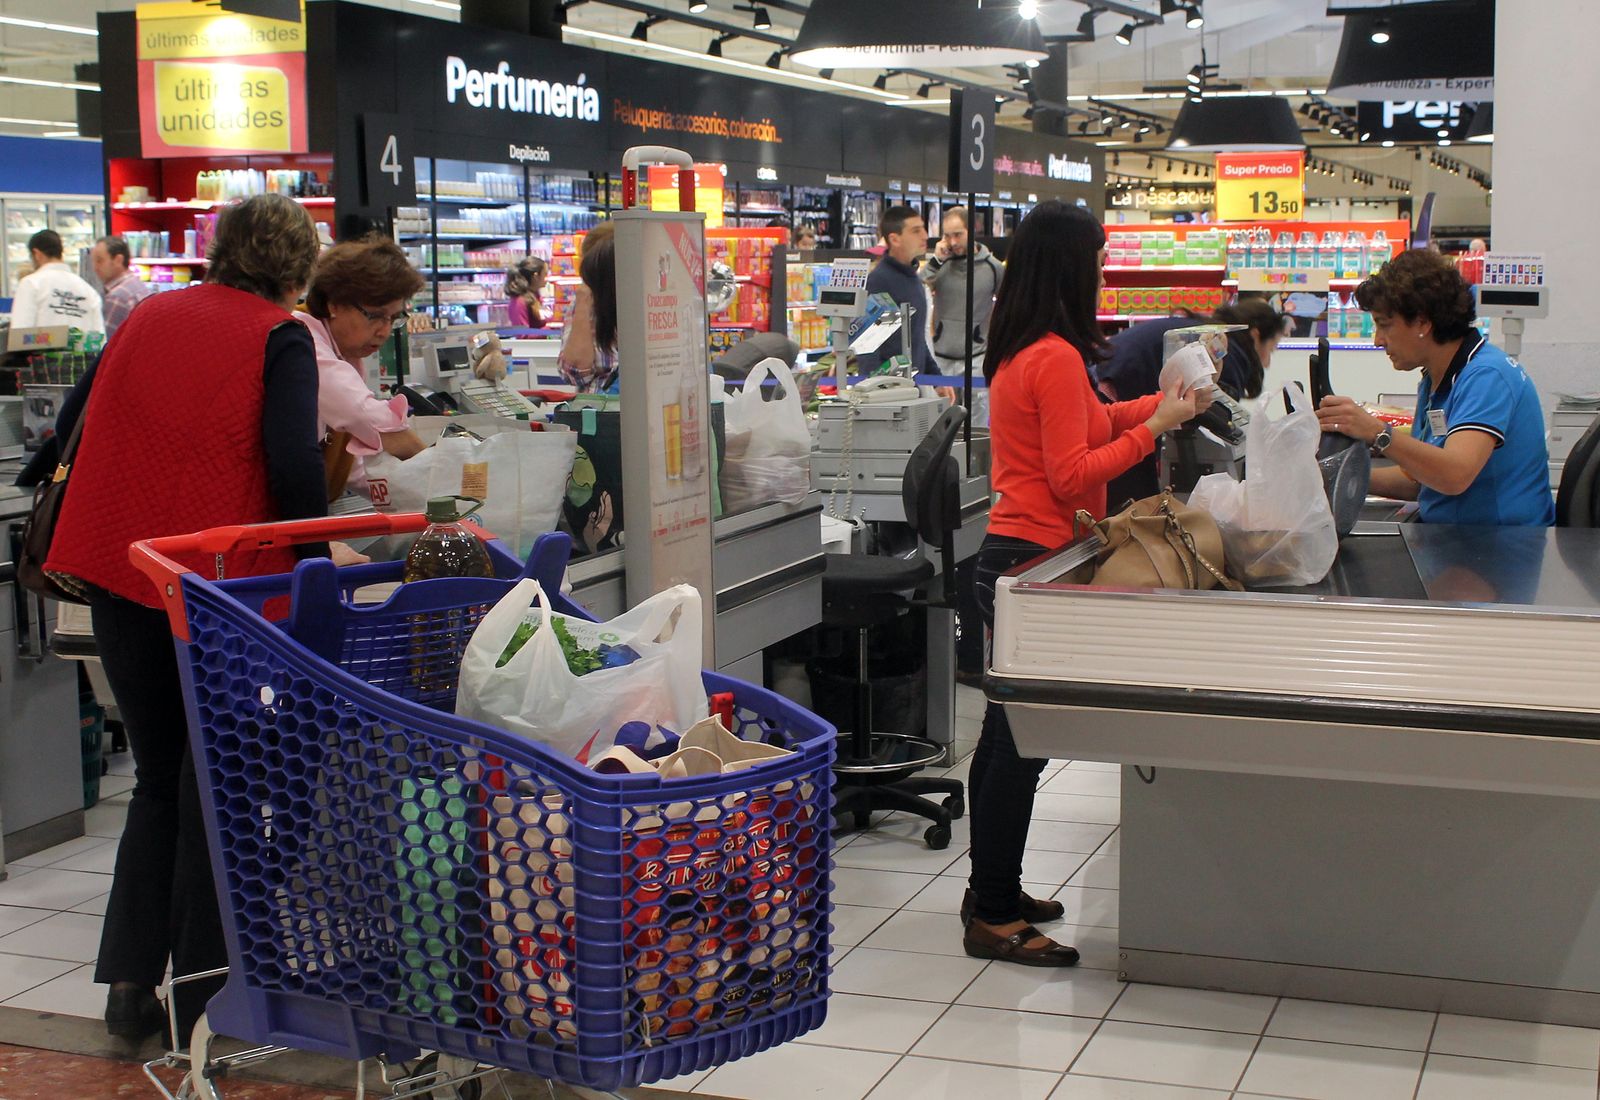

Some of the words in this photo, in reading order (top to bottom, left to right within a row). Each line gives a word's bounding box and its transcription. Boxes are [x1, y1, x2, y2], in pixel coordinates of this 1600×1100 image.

[146, 31, 209, 49] últimas
[175, 78, 270, 102] últias
[446, 55, 600, 122] Perfumería
[162, 106, 284, 132] unidades
[509, 144, 550, 163] Depilación
[970, 113, 985, 171] 3
[380, 134, 403, 186] 4
[1224, 164, 1256, 177] Super
[1258, 163, 1293, 175] Precio
[1111, 191, 1132, 206] La
[1249, 190, 1279, 214] 13
[1281, 201, 1299, 214] 50
[647, 311, 679, 331] FRESCA
